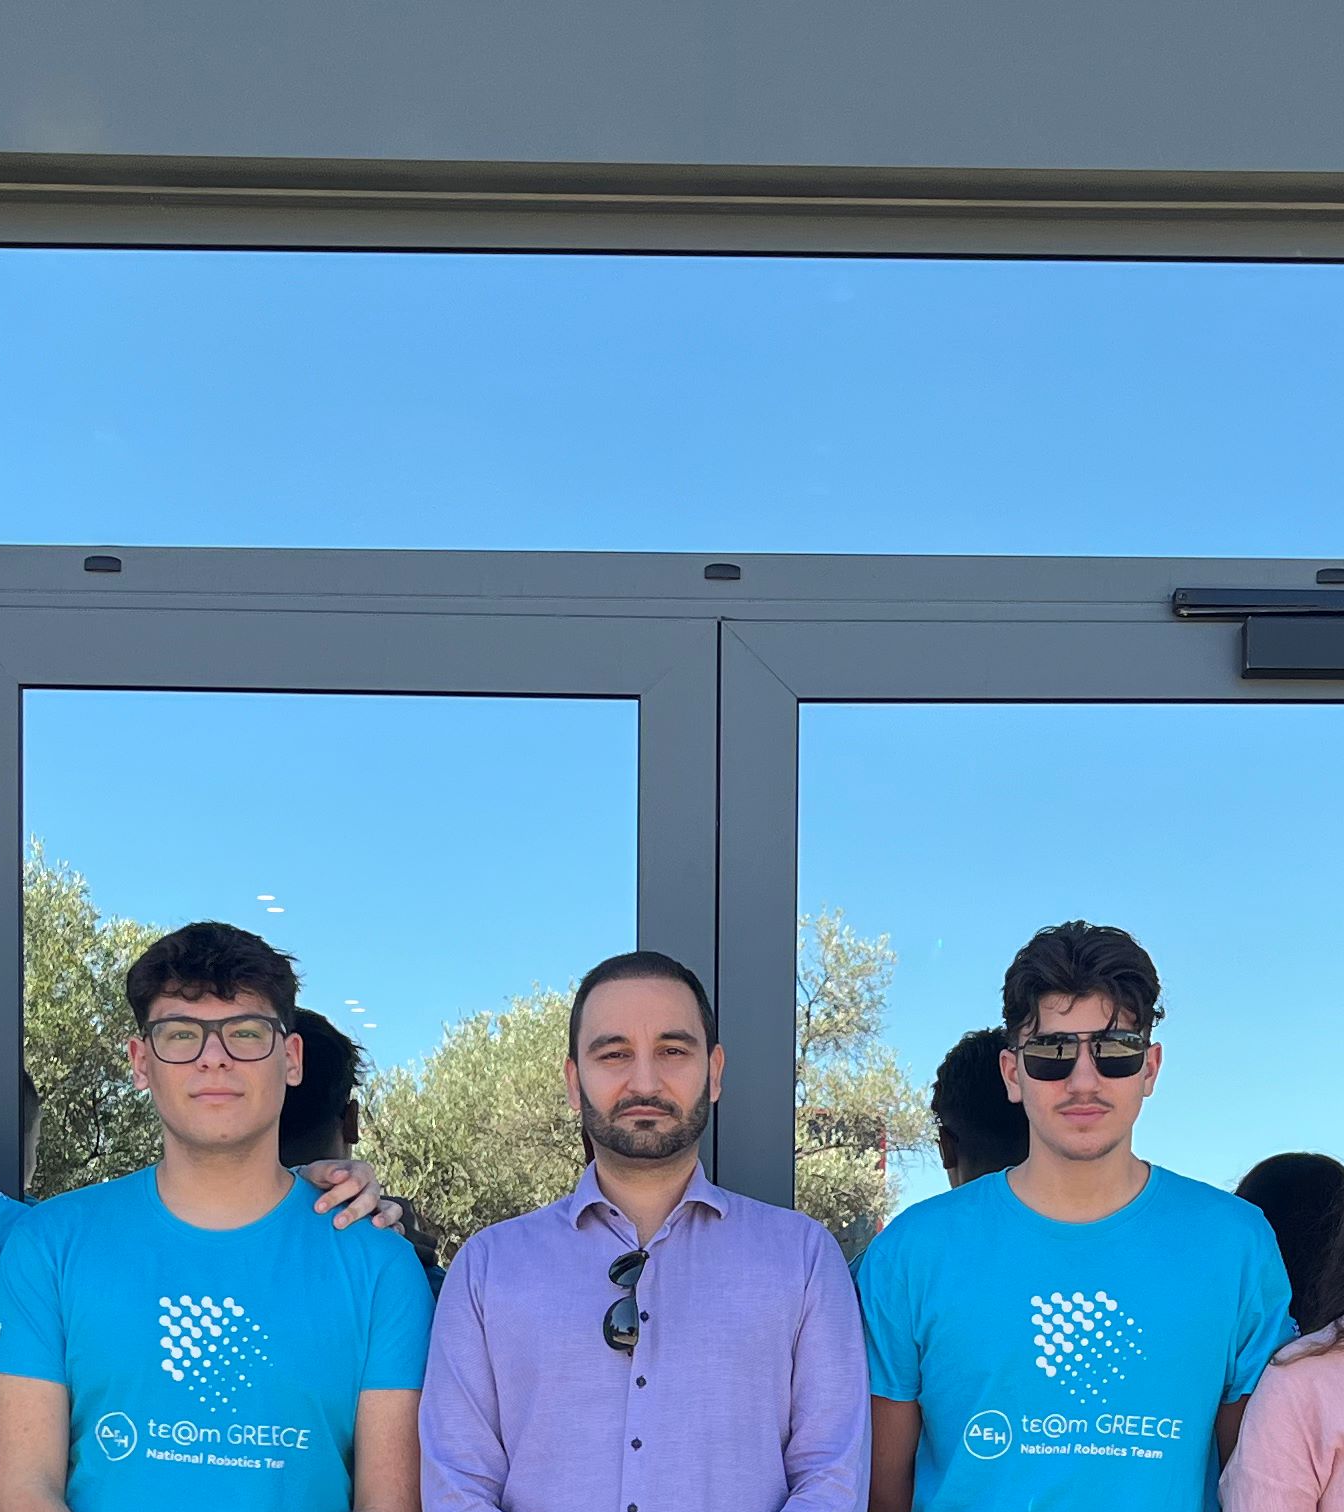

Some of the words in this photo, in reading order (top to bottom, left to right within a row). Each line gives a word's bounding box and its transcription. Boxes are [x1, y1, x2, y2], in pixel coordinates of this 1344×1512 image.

[227, 1424, 310, 1449] GREECE
[1096, 1414, 1182, 1439] GREECE
[147, 1449, 203, 1463] National
[208, 1454, 261, 1468] Robotics
[1021, 1444, 1071, 1454] National
[1074, 1443, 1127, 1456] Robotics
[1131, 1447, 1163, 1458] Team
